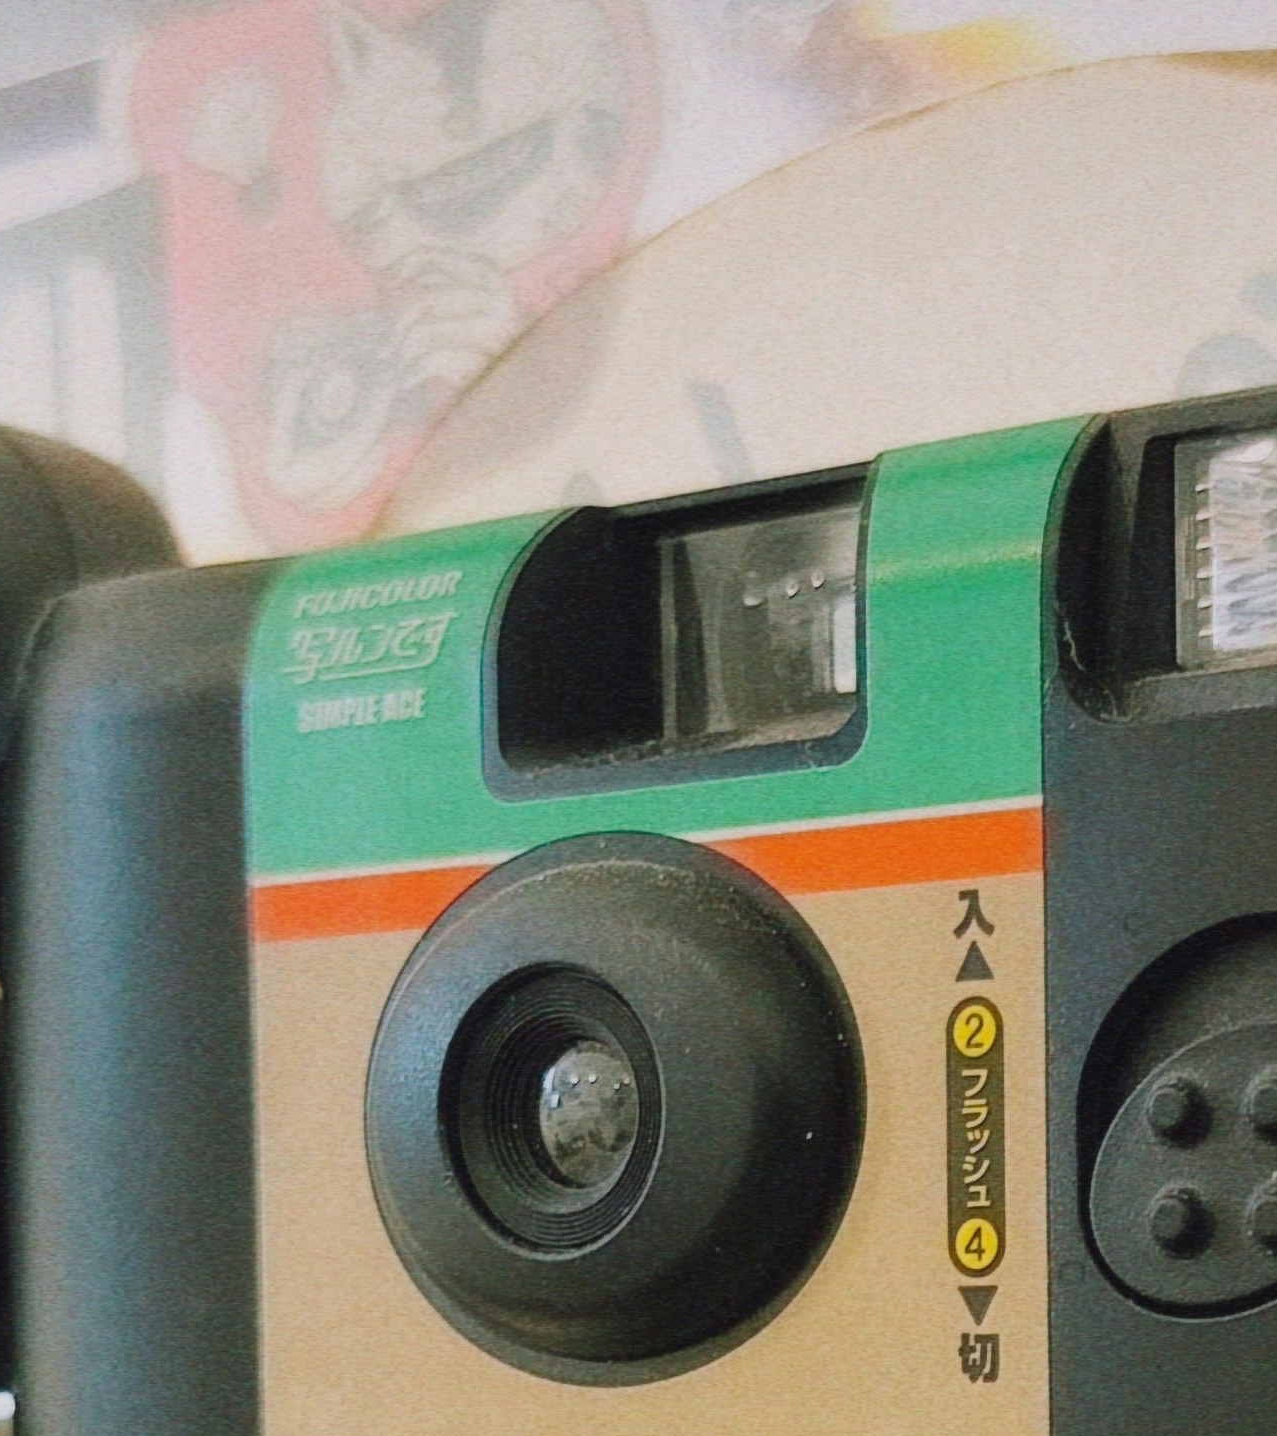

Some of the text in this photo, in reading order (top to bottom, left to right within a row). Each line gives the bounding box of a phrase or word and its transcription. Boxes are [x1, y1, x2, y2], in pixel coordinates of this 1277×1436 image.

[294, 571, 462, 618] FUJICOLOR
[300, 688, 426, 732] SIMPLE ACE
[952, 888, 996, 940] 入
[960, 1067, 992, 1209] フラッシュ
[957, 1332, 1001, 1385] 切
